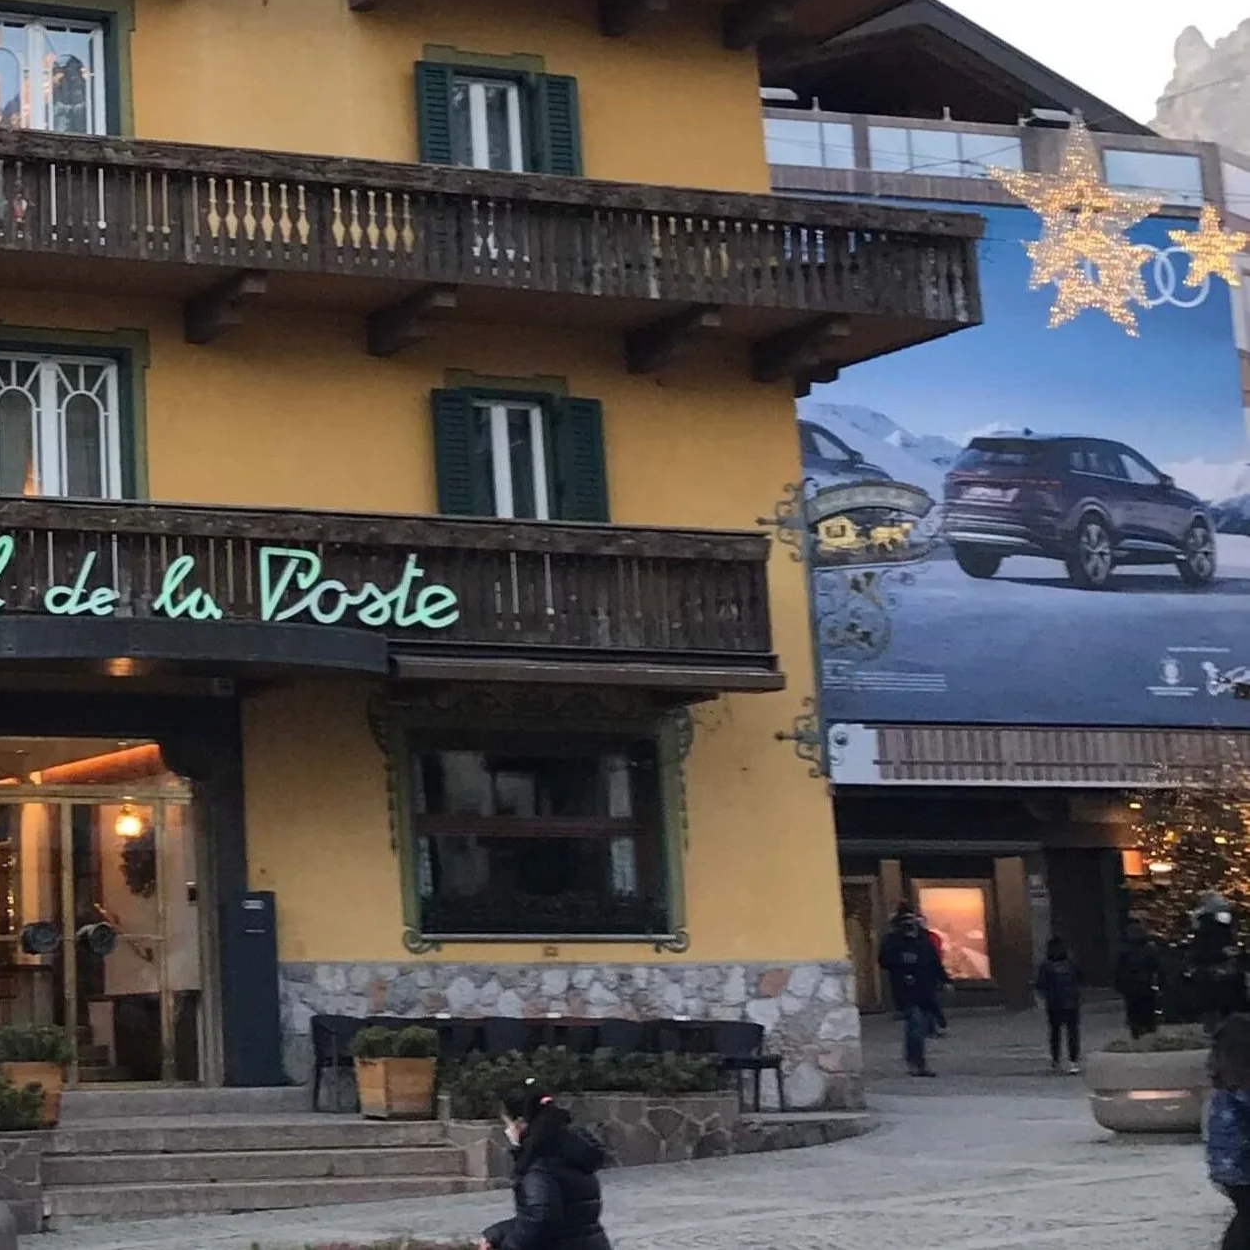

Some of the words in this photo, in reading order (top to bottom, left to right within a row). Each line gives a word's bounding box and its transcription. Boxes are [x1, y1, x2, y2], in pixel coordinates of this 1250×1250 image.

[44, 551, 118, 615] de
[153, 555, 223, 619] la
[259, 546, 459, 628] Poste
